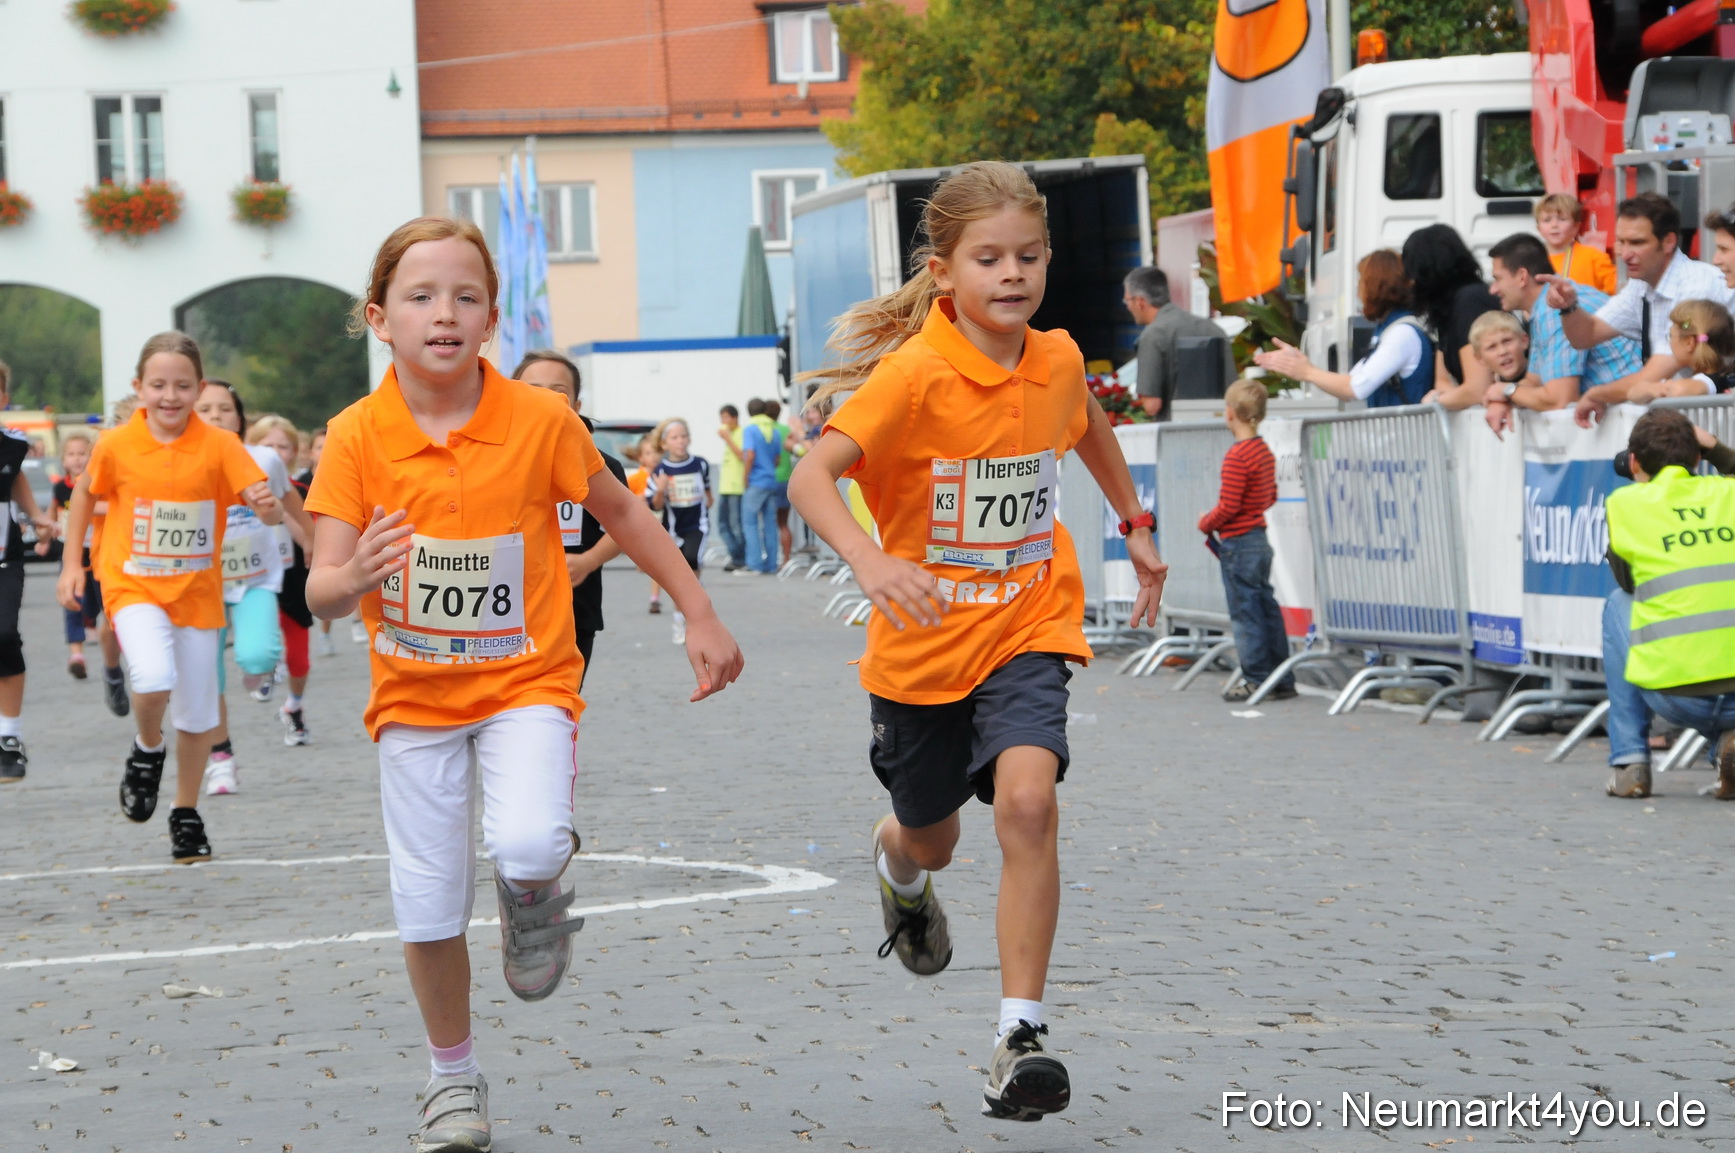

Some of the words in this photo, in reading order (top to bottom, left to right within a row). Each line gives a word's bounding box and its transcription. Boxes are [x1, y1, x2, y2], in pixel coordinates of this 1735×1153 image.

[975, 458, 1040, 479] Theresa
[936, 493, 955, 510] K3
[975, 487, 1049, 529] 7075
[155, 507, 187, 521] Anika
[1673, 507, 1706, 521] TV
[134, 525, 146, 535] K3
[157, 529, 207, 547] 7079
[1662, 526, 1734, 552] FOTO
[416, 546, 490, 572] Annette
[383, 575, 400, 592] K3
[934, 577, 999, 604] ERZ
[418, 583, 512, 618] 7078
[467, 636, 523, 648] PFLEIDERER
